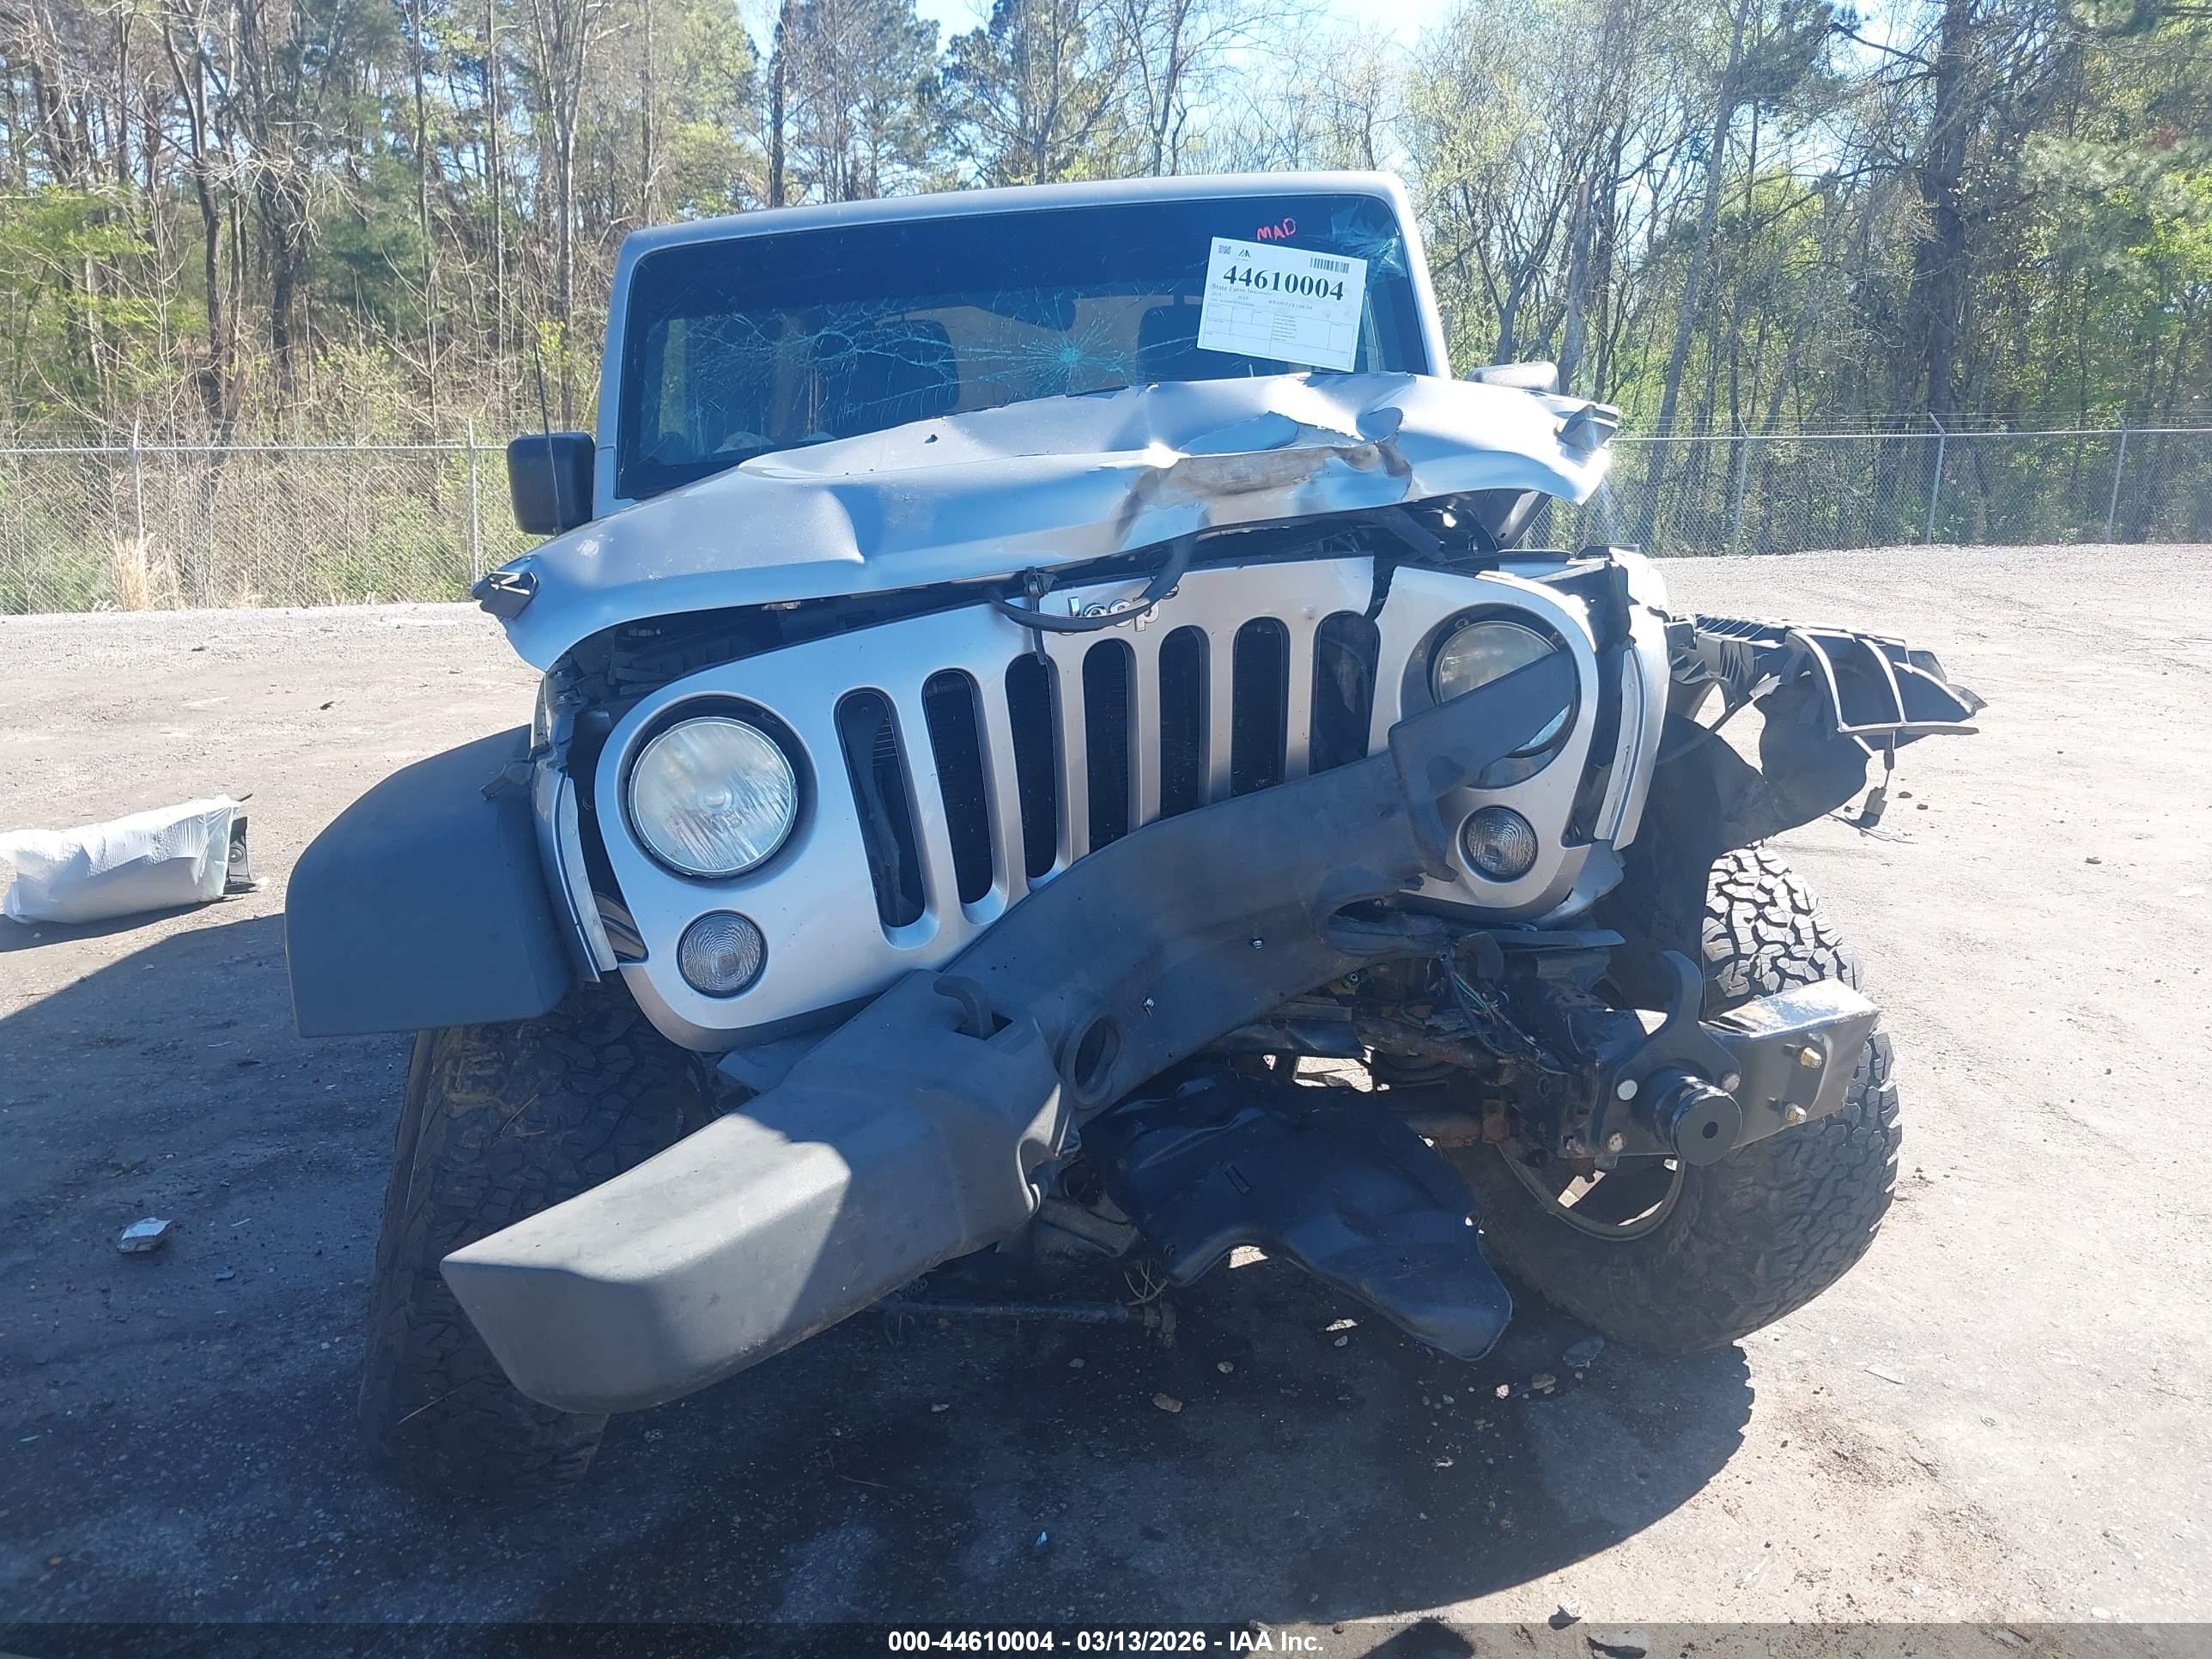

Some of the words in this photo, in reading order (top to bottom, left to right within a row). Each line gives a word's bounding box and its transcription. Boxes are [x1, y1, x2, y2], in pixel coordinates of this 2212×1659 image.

[1256, 217, 1297, 240] MAD
[1212, 283, 1227, 291] State
[1223, 265, 1344, 301] 44610004
